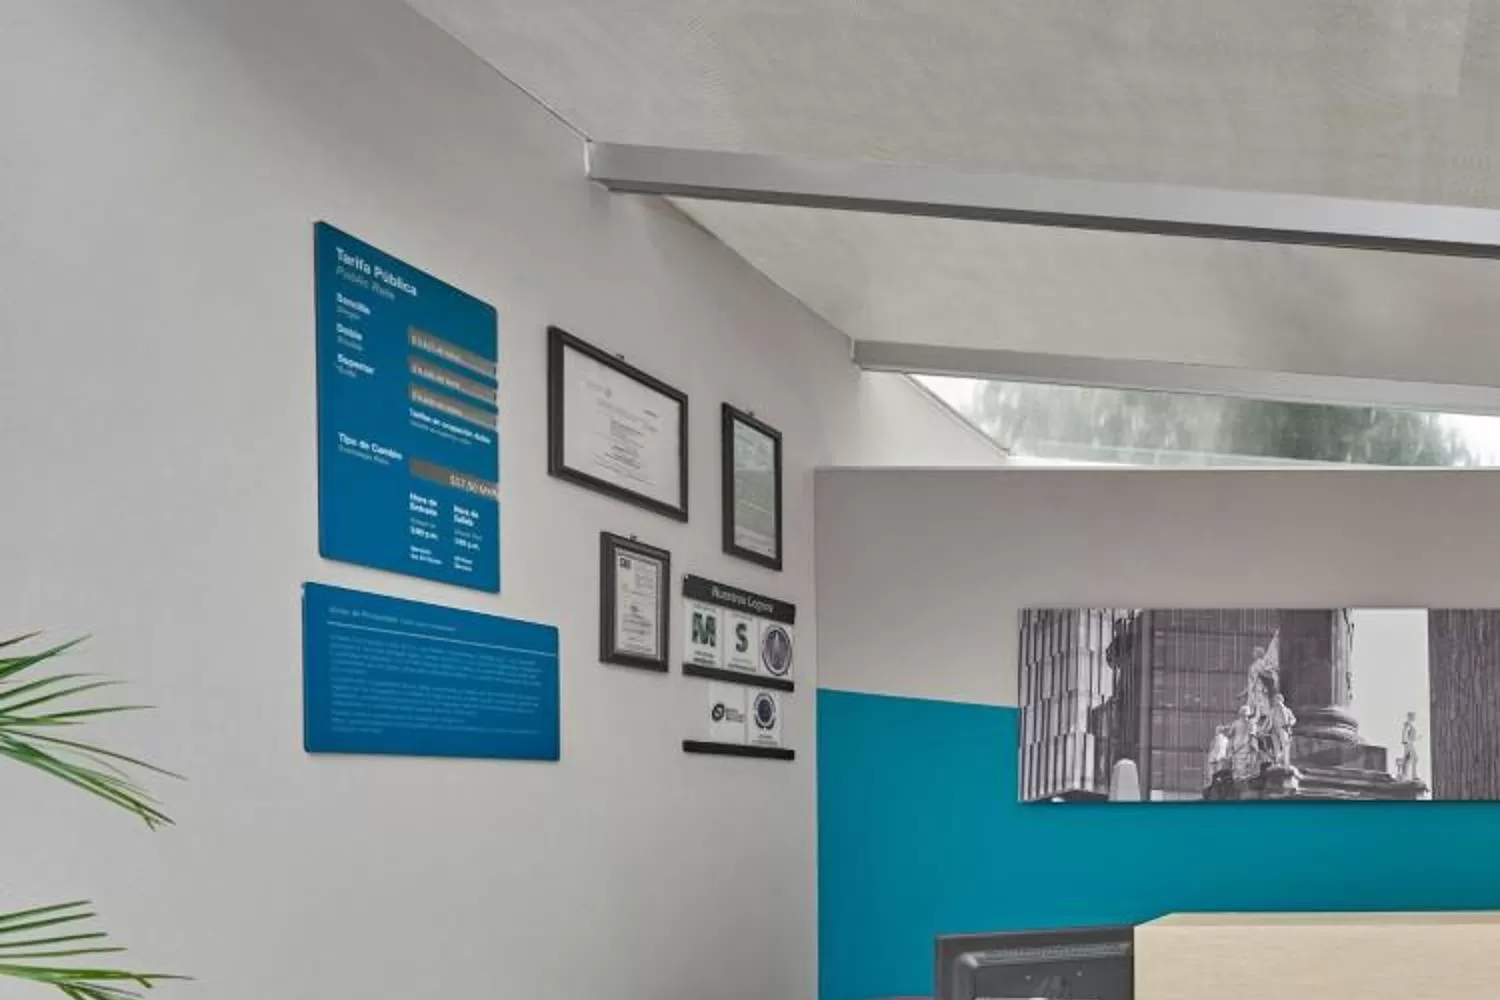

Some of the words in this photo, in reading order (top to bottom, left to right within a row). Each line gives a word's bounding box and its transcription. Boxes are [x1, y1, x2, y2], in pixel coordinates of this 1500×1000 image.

[335, 246, 371, 275] Tarifa
[373, 264, 417, 297] Pública
[735, 621, 749, 653] S
